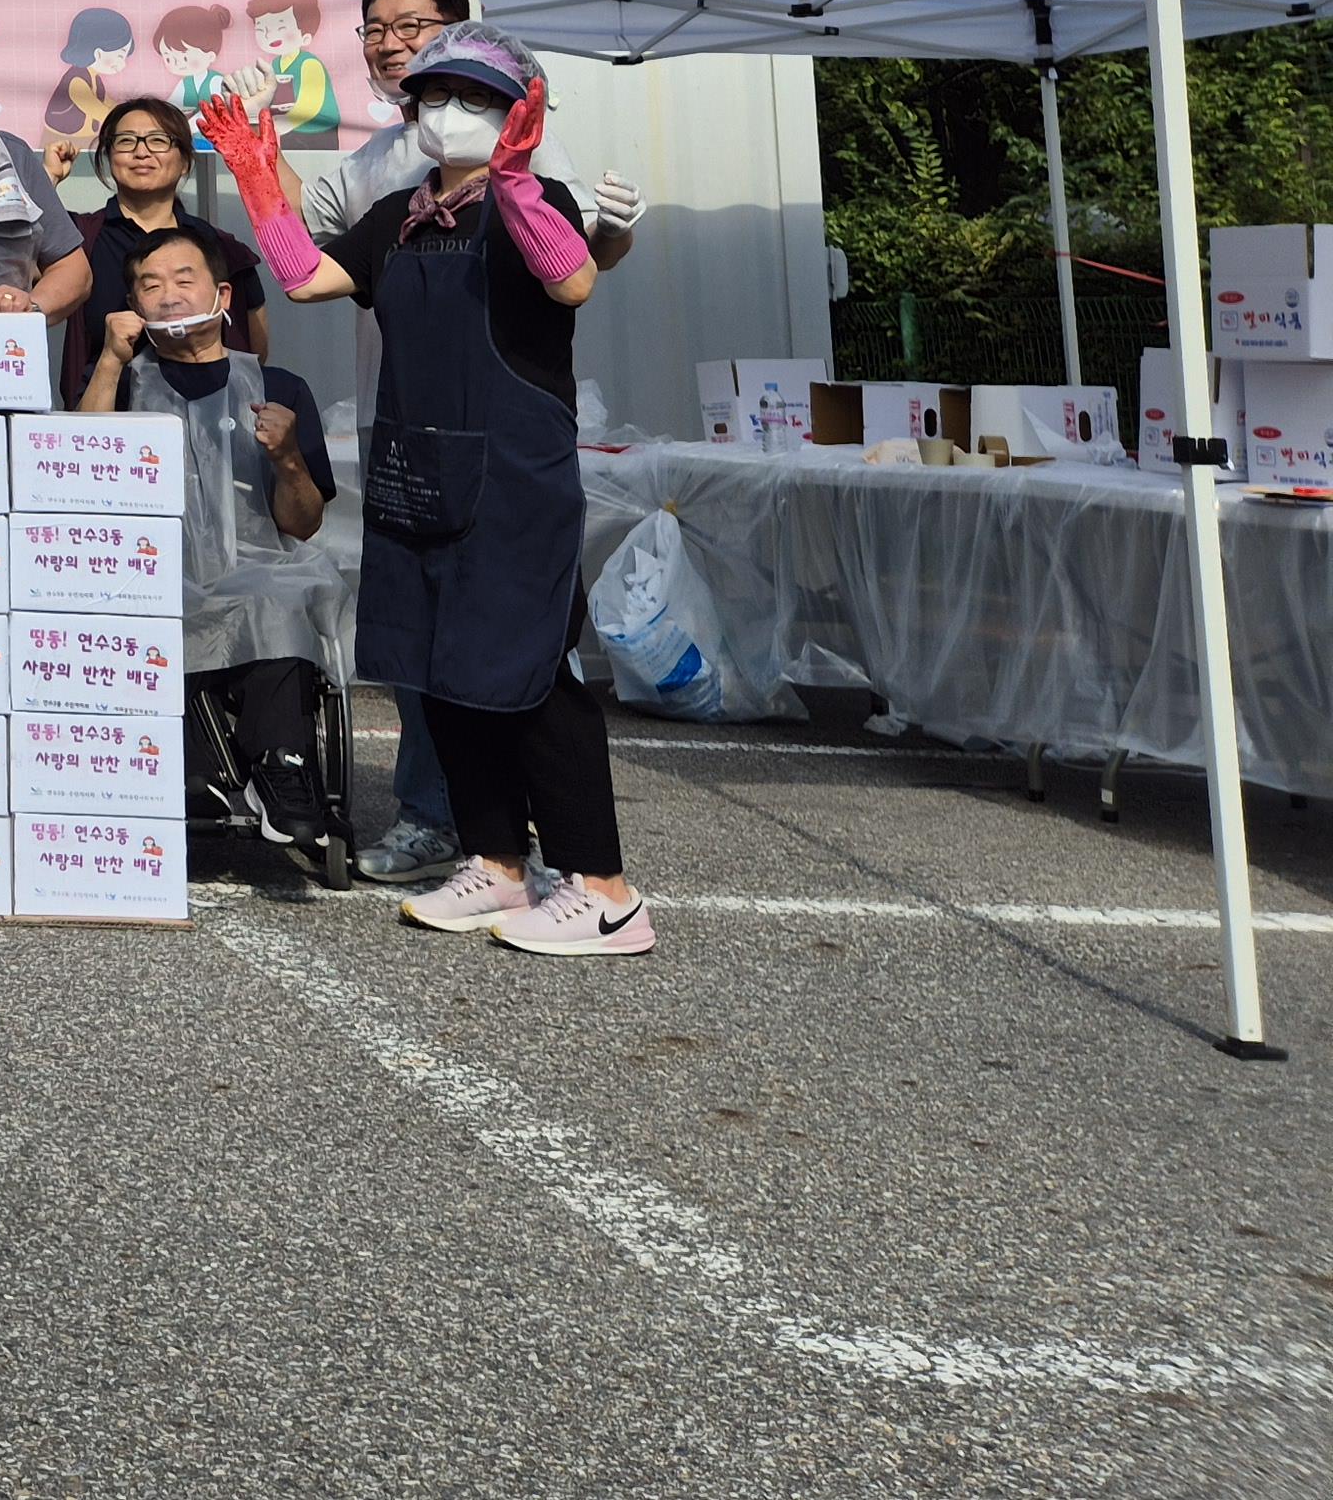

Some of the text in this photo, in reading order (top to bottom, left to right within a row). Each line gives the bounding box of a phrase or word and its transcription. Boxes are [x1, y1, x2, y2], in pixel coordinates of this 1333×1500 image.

[24, 525, 125, 547] 띵동! 연수3동
[35, 554, 158, 577] 사랑의 반찬 배달
[29, 628, 140, 658] 띵동! 연수3동
[22, 660, 161, 692] 사랑의 반찬 배달
[26, 722, 126, 746] 띵동! 연수3동
[36, 751, 160, 777] 사랑의 반찬 배달
[31, 822, 130, 846] 띵동! 연수3동
[39, 852, 163, 878] 사랑의 반찬 배달
